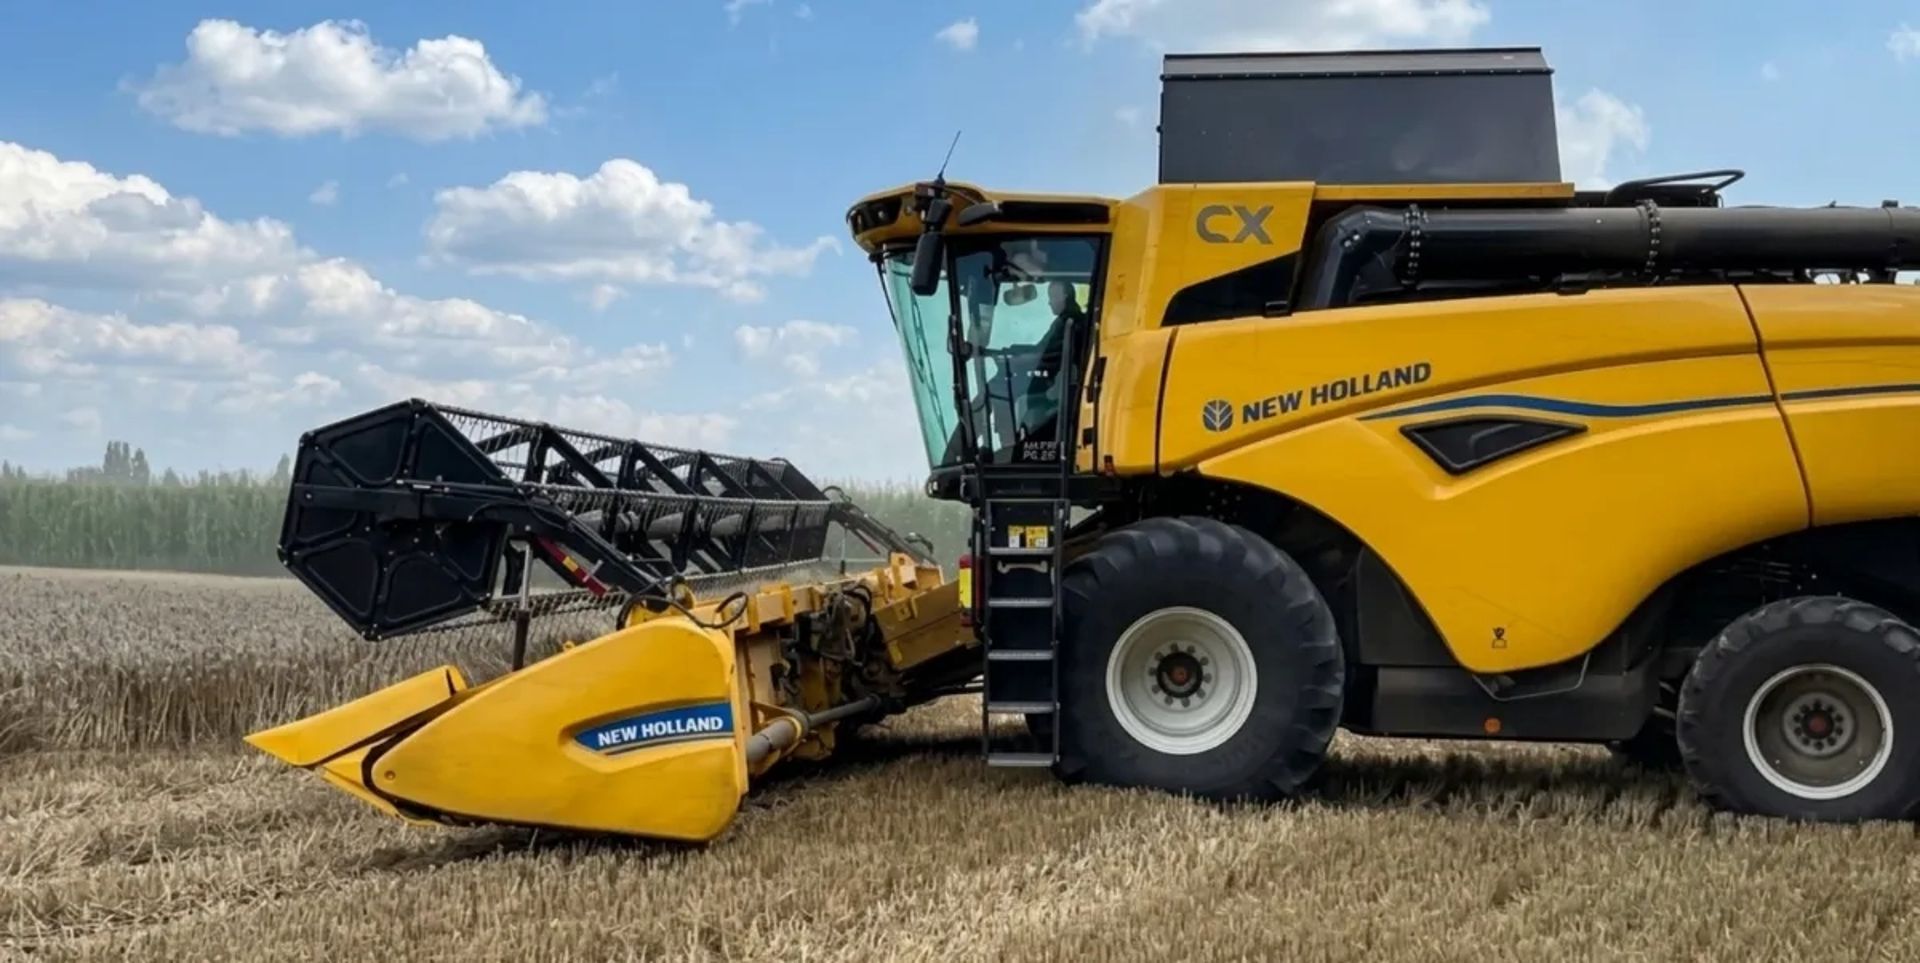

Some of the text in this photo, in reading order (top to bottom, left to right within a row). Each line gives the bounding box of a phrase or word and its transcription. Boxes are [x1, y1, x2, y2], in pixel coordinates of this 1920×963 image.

[1196, 204, 1274, 245] CX
[1242, 362, 1432, 424] NEW HOLLAND
[597, 716, 724, 747] NEW HOLLAND
